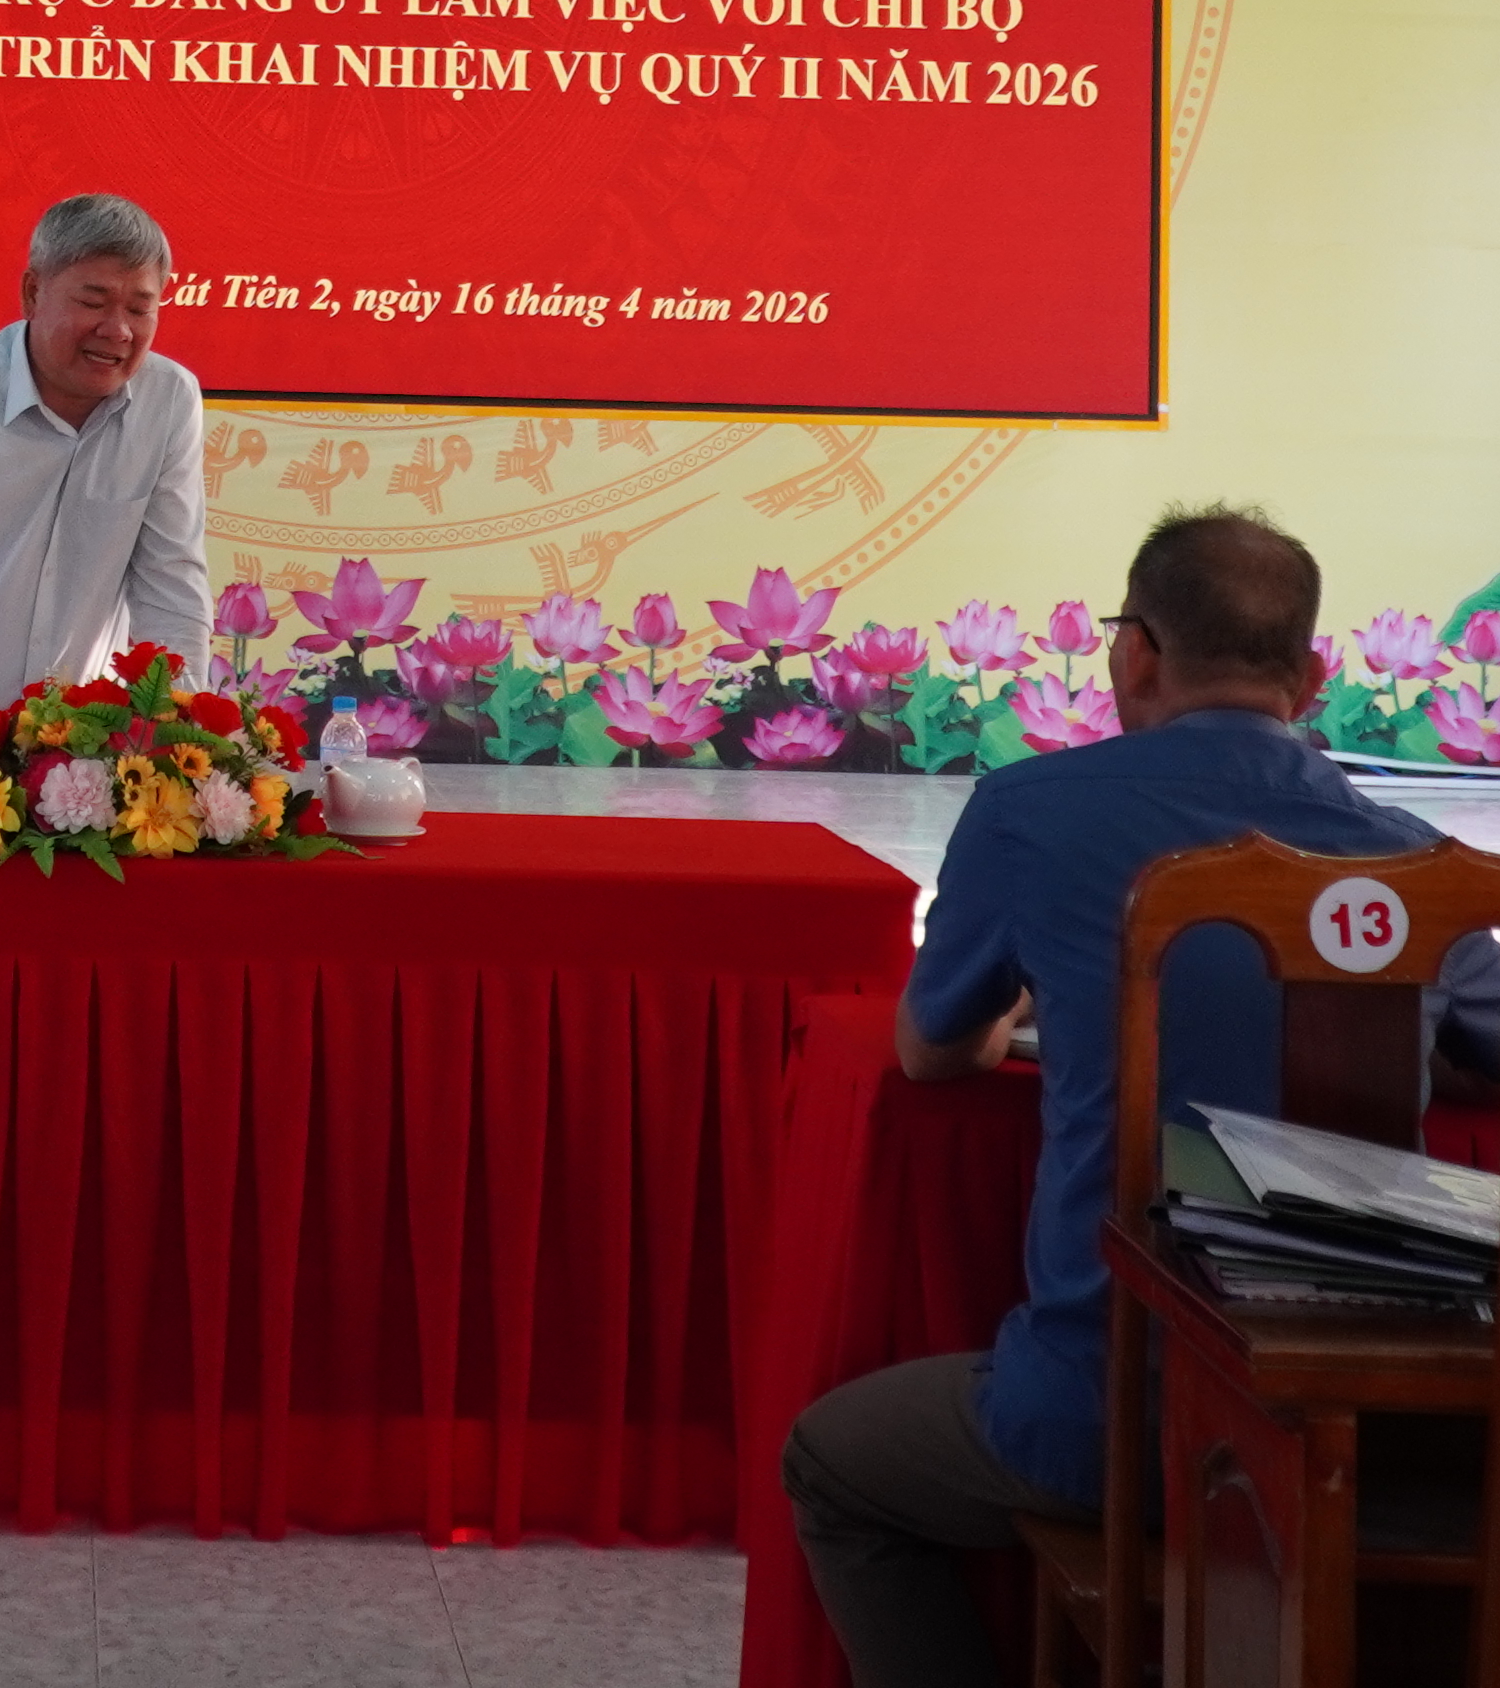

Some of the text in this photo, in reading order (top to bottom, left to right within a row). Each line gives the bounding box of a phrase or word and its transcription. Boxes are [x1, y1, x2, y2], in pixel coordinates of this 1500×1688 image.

[170, 40, 319, 85] KHAI
[334, 41, 531, 100] NHIỆM
[545, 50, 625, 105] VỤ
[640, 43, 765, 104] QUÝ
[780, 57, 822, 99] II
[837, 49, 971, 103] NĂM
[986, 62, 1098, 107] 2026
[223, 275, 299, 309] Tiên
[310, 278, 340, 317] 2,
[353, 279, 441, 322] ngày
[452, 283, 495, 314] 16
[504, 283, 610, 327] tháng
[619, 287, 642, 318] 4
[651, 288, 731, 321] năm
[741, 290, 829, 323] 2026
[1330, 901, 1392, 948] 13
